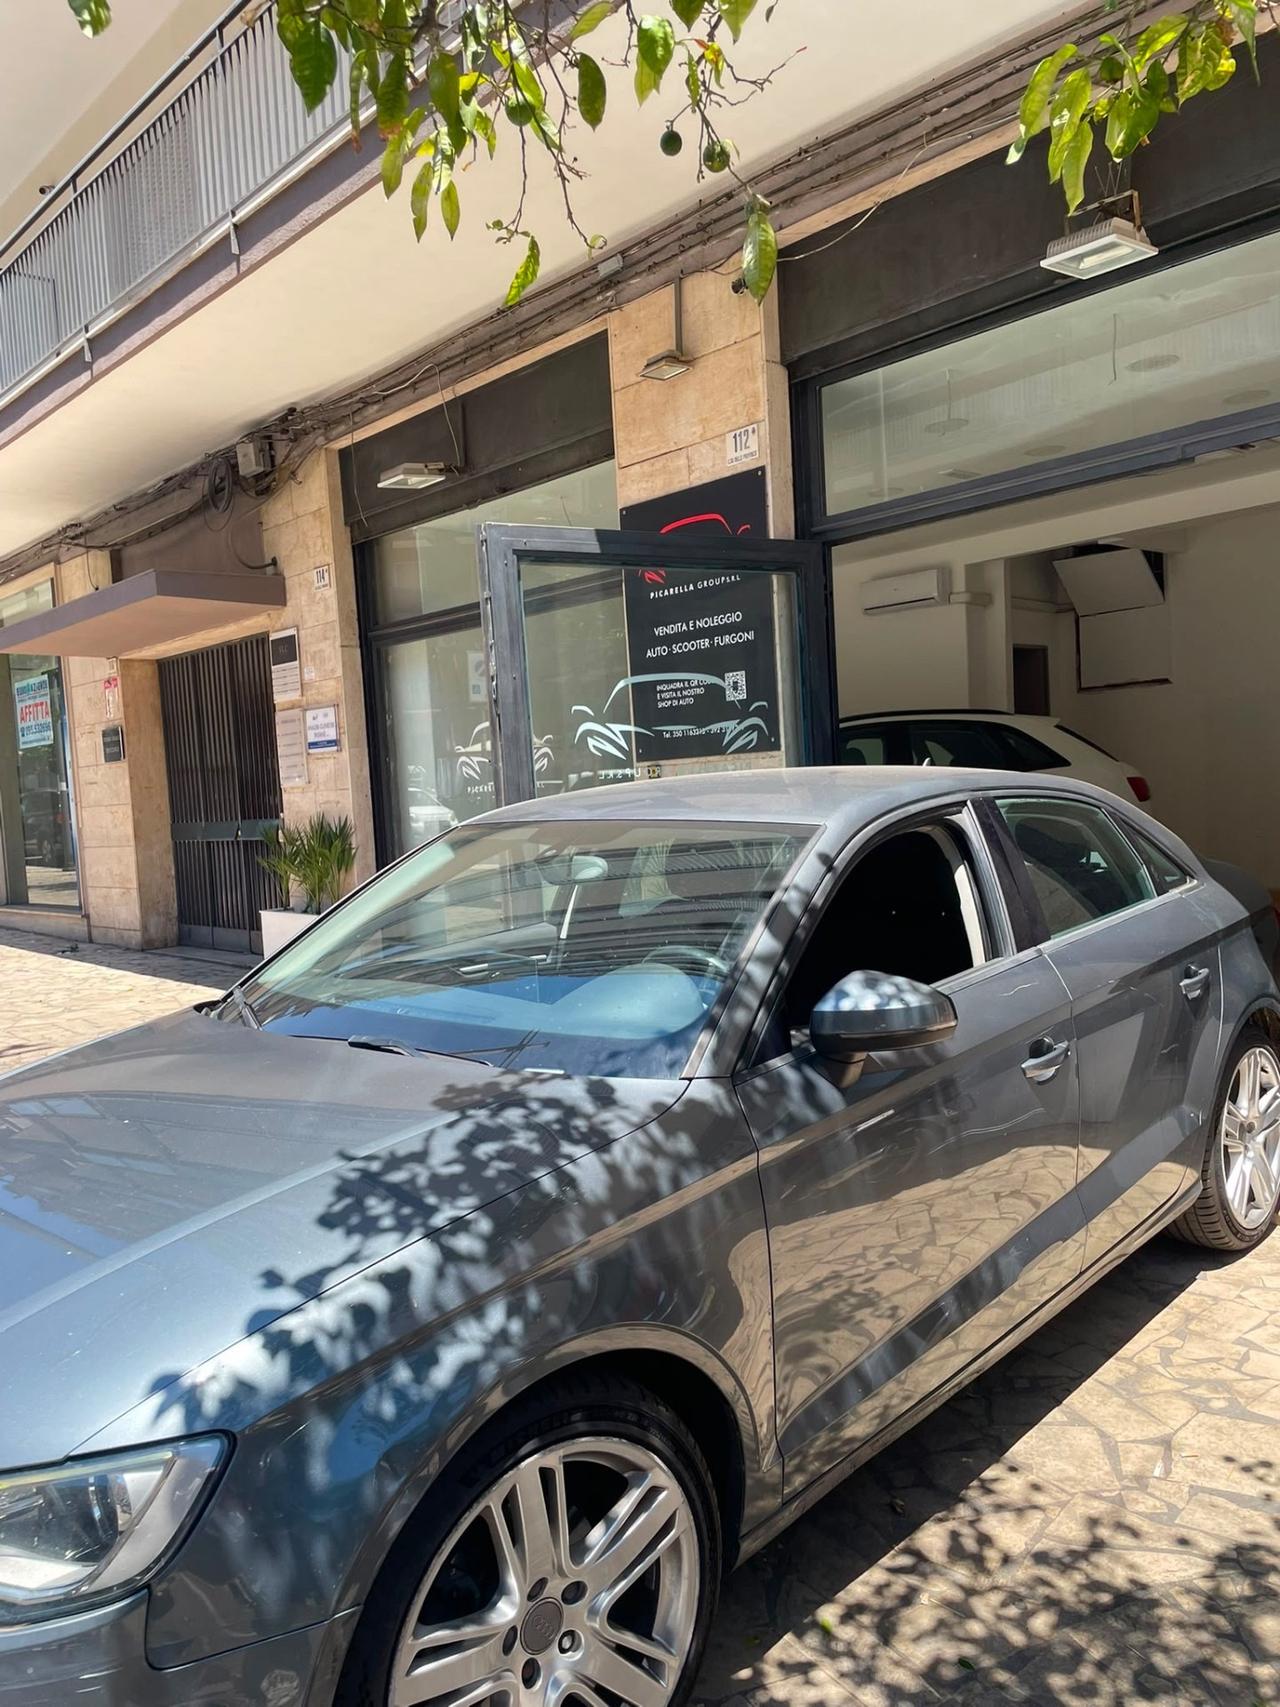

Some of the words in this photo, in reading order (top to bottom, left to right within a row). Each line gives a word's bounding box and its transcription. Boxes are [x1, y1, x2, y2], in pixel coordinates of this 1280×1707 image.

[650, 583, 695, 600] PICARELLA
[653, 622, 688, 636] VENDITA
[689, 620, 695, 631] E
[696, 611, 743, 629] NOLEGGIO
[646, 645, 668, 658] AUTO
[672, 638, 710, 654] SCOOTER
[714, 630, 755, 647] FURGONI
[657, 700, 671, 708] SHOP
[679, 697, 694, 705] AUTO
[661, 691, 676, 699] VISITA
[682, 687, 705, 696] NOSTRO
[20, 700, 50, 724] AFFITTA
